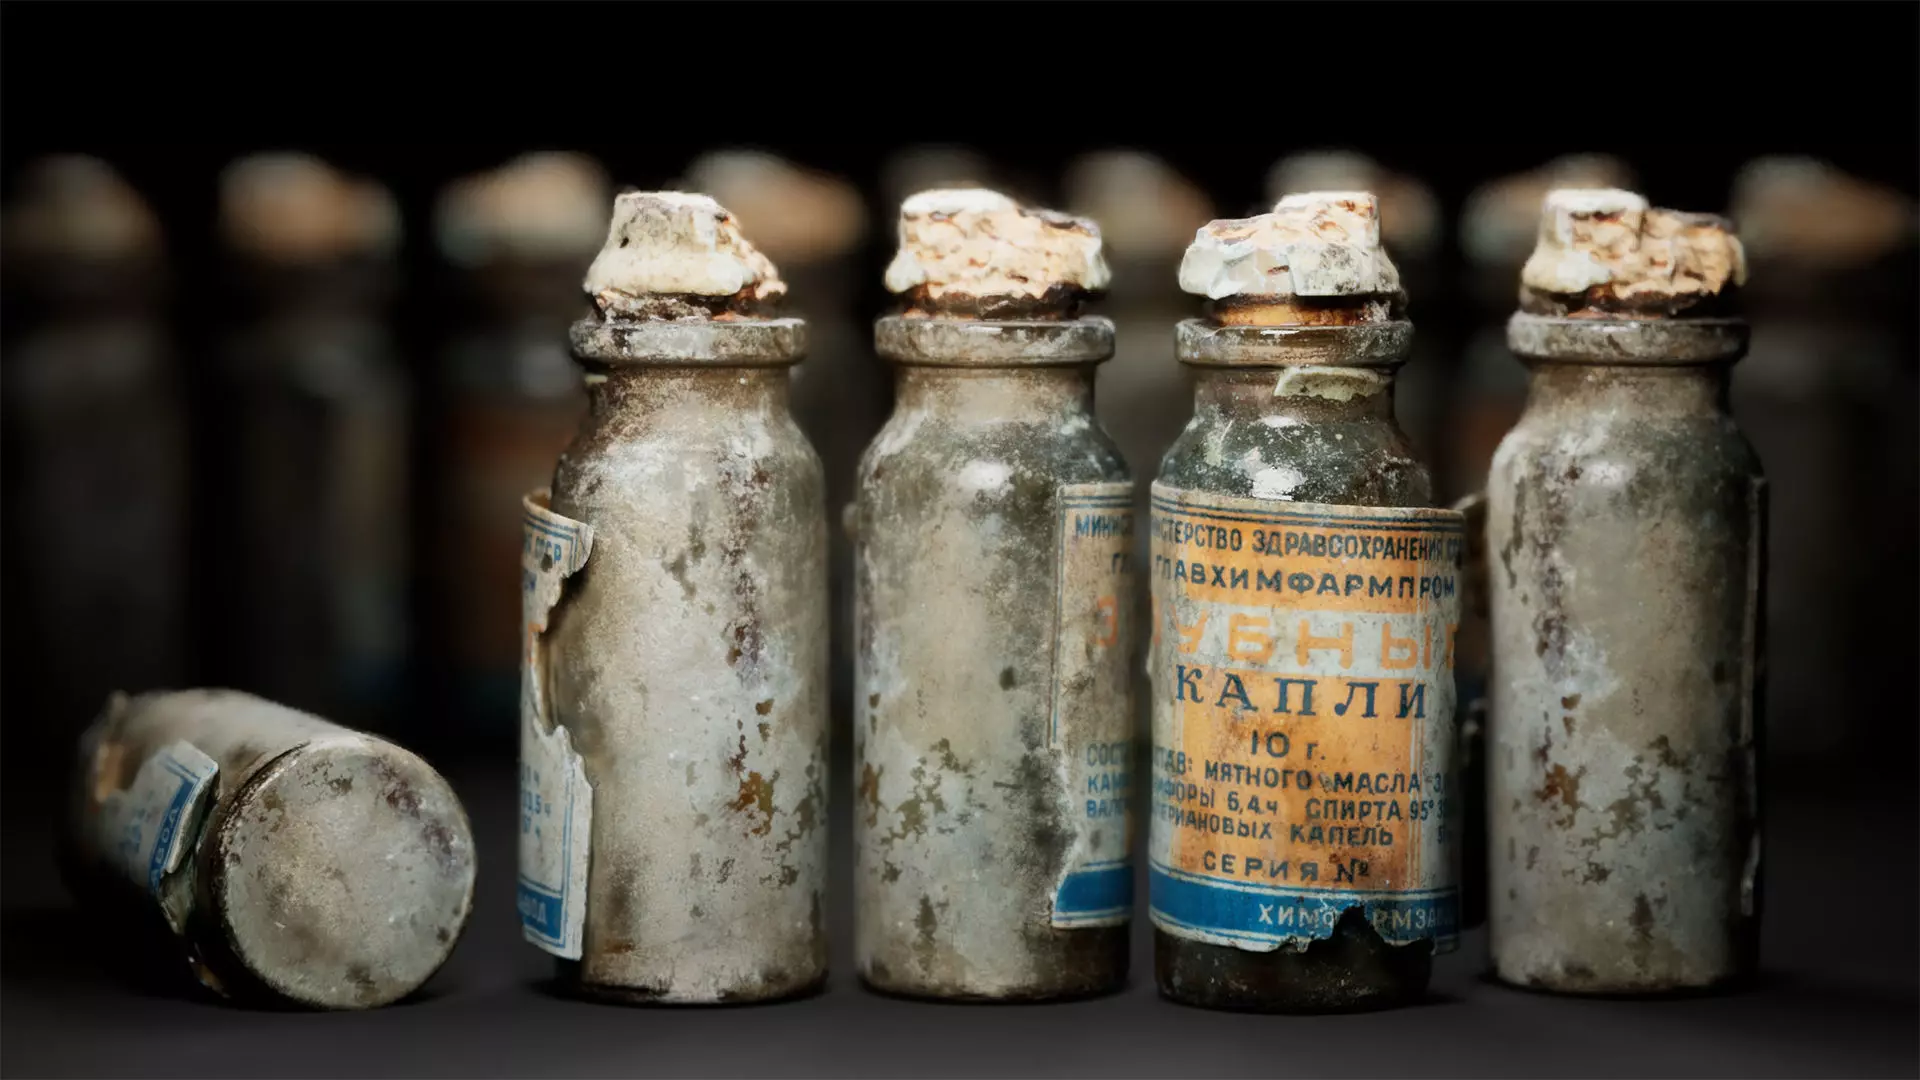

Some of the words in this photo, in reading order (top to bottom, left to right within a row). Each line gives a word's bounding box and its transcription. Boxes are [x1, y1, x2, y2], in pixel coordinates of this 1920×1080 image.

[1175, 664, 1428, 720] КАПЛИ
[1251, 729, 1290, 758] 10
[1204, 759, 1314, 791] МЯТНОГО
[1332, 772, 1421, 795] МАСЛА
[1305, 797, 1402, 821] СПИРТА
[1289, 823, 1394, 848] КАПЕЛЬ
[1203, 850, 1319, 882] СЕРИЯ
